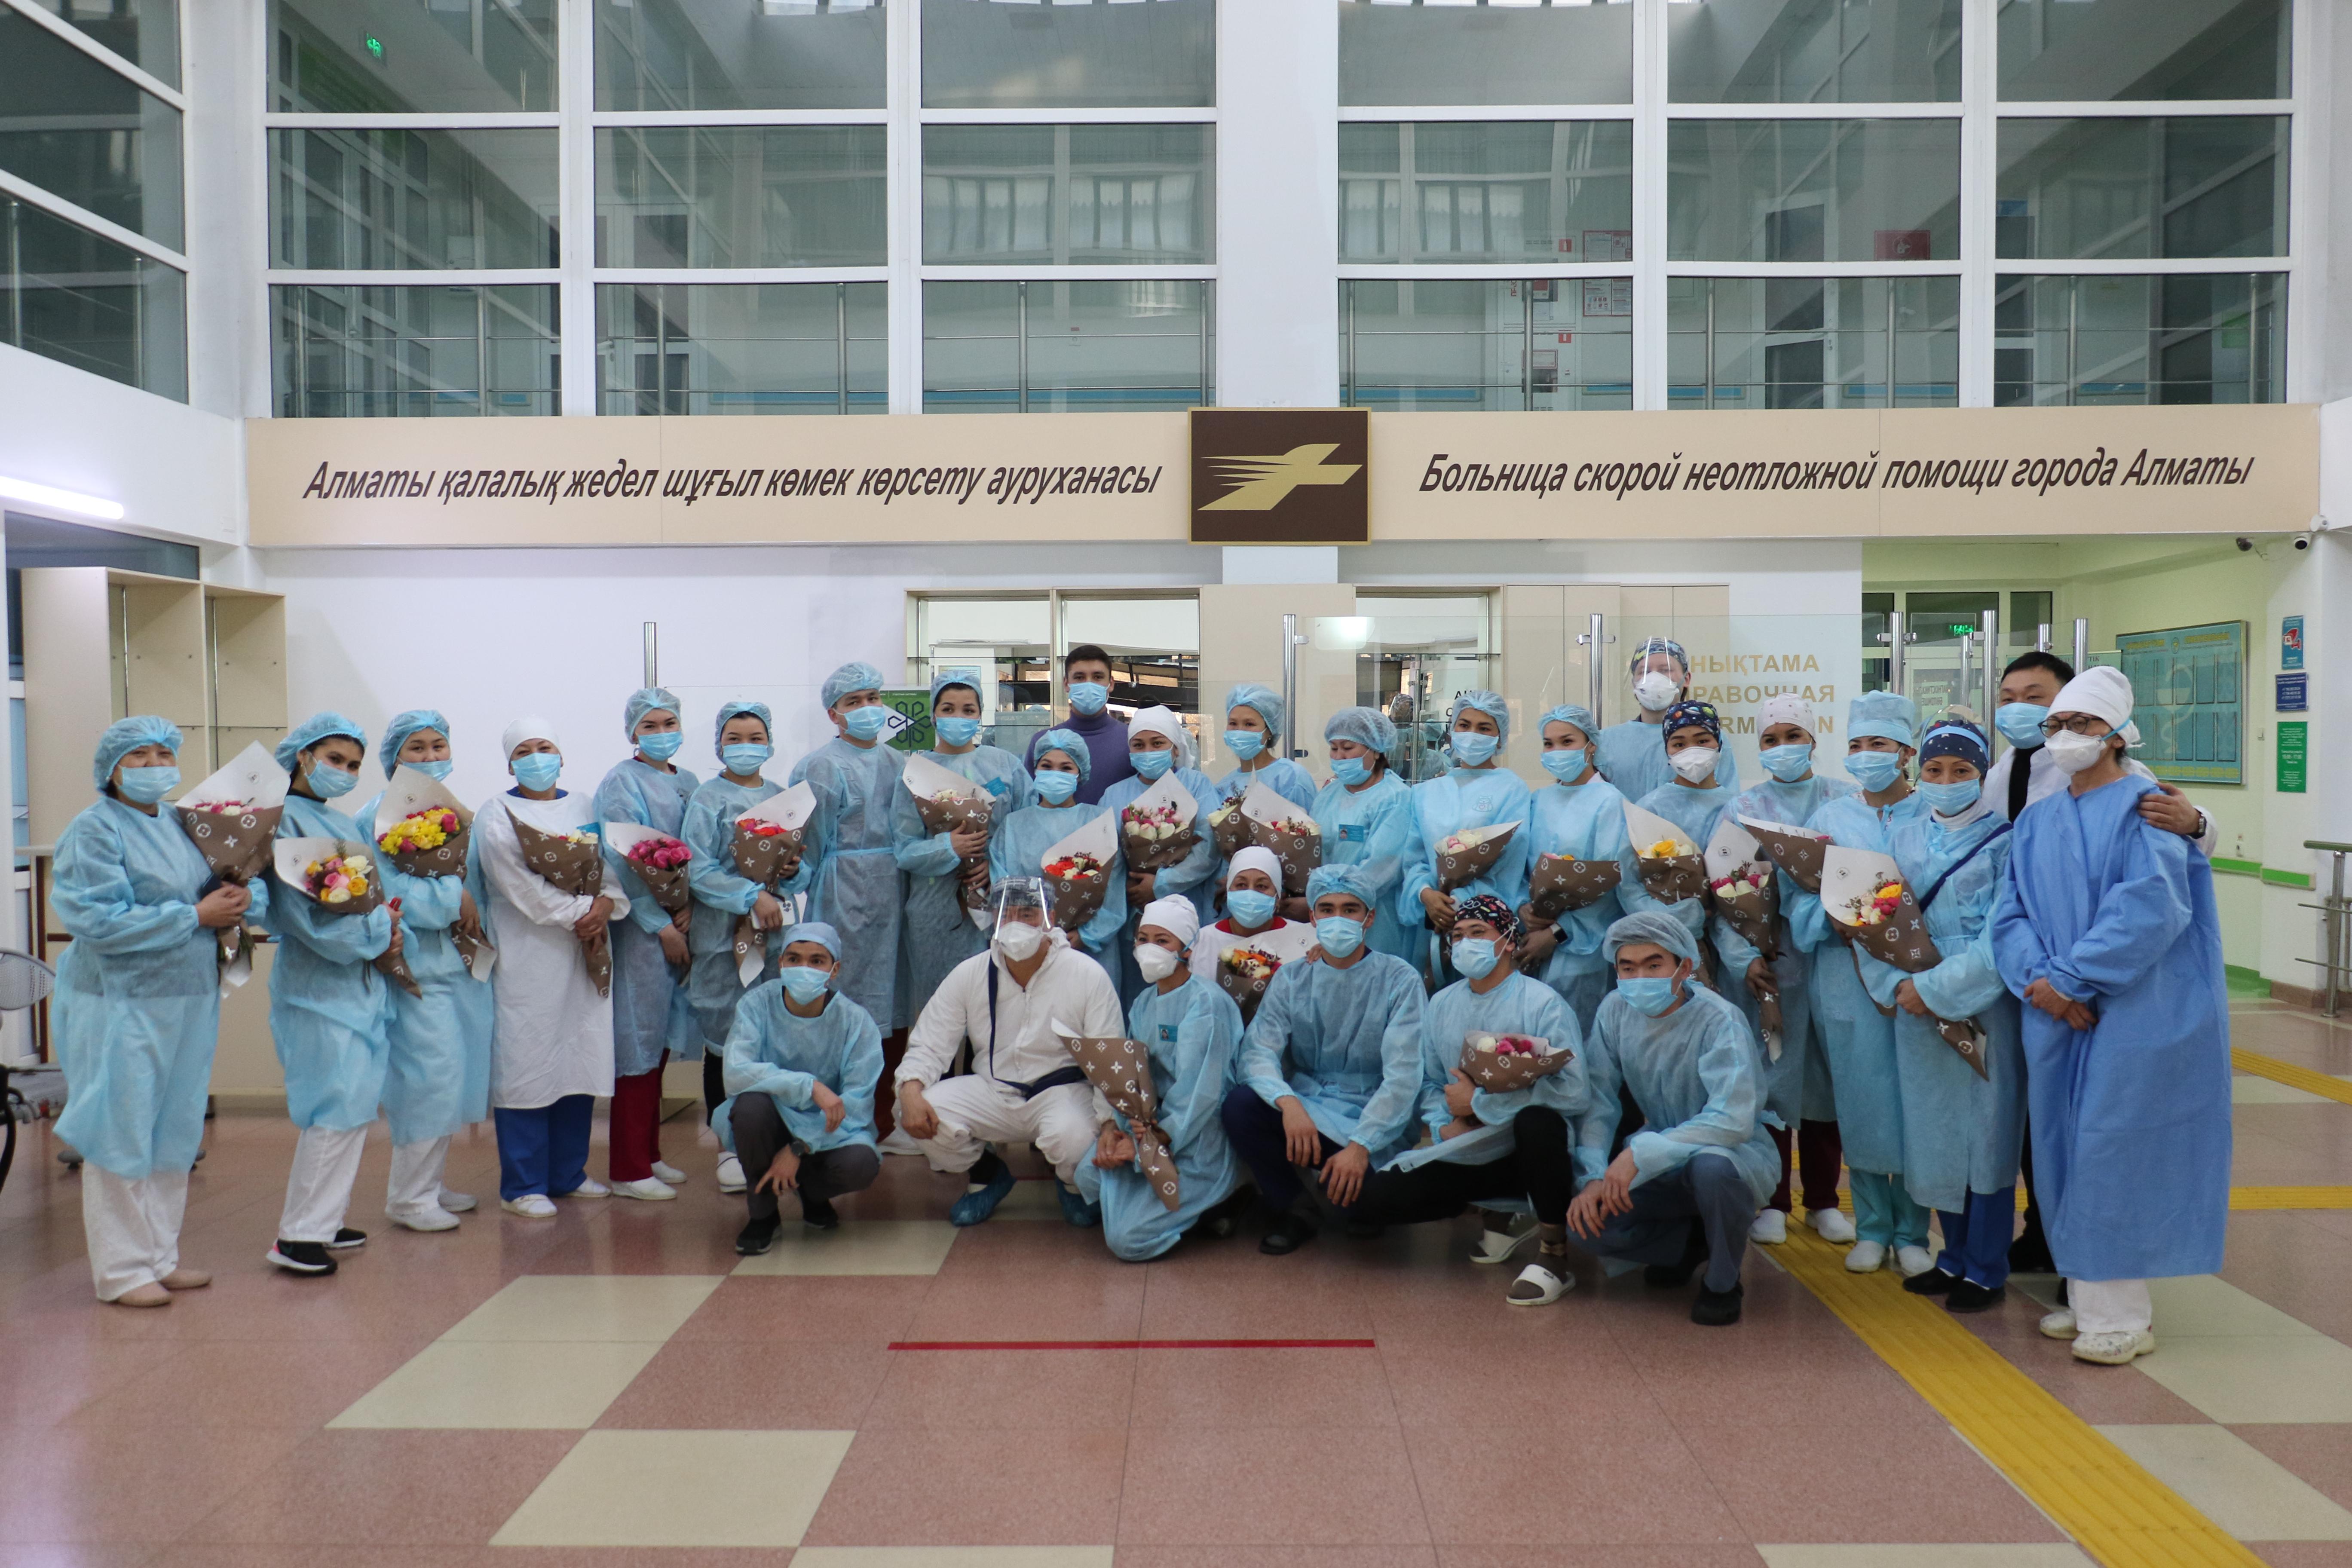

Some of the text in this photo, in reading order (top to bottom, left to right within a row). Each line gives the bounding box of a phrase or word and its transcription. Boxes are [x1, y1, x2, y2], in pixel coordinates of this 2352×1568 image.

[302, 458, 1163, 506] Алматы қалалық жедел шұғыл көмек көрсету ауруханасы
[1418, 446, 2255, 501] Больница скорой неотложной помощи города Алматы
[1690, 655, 1820, 676] НЫҚТАМА
